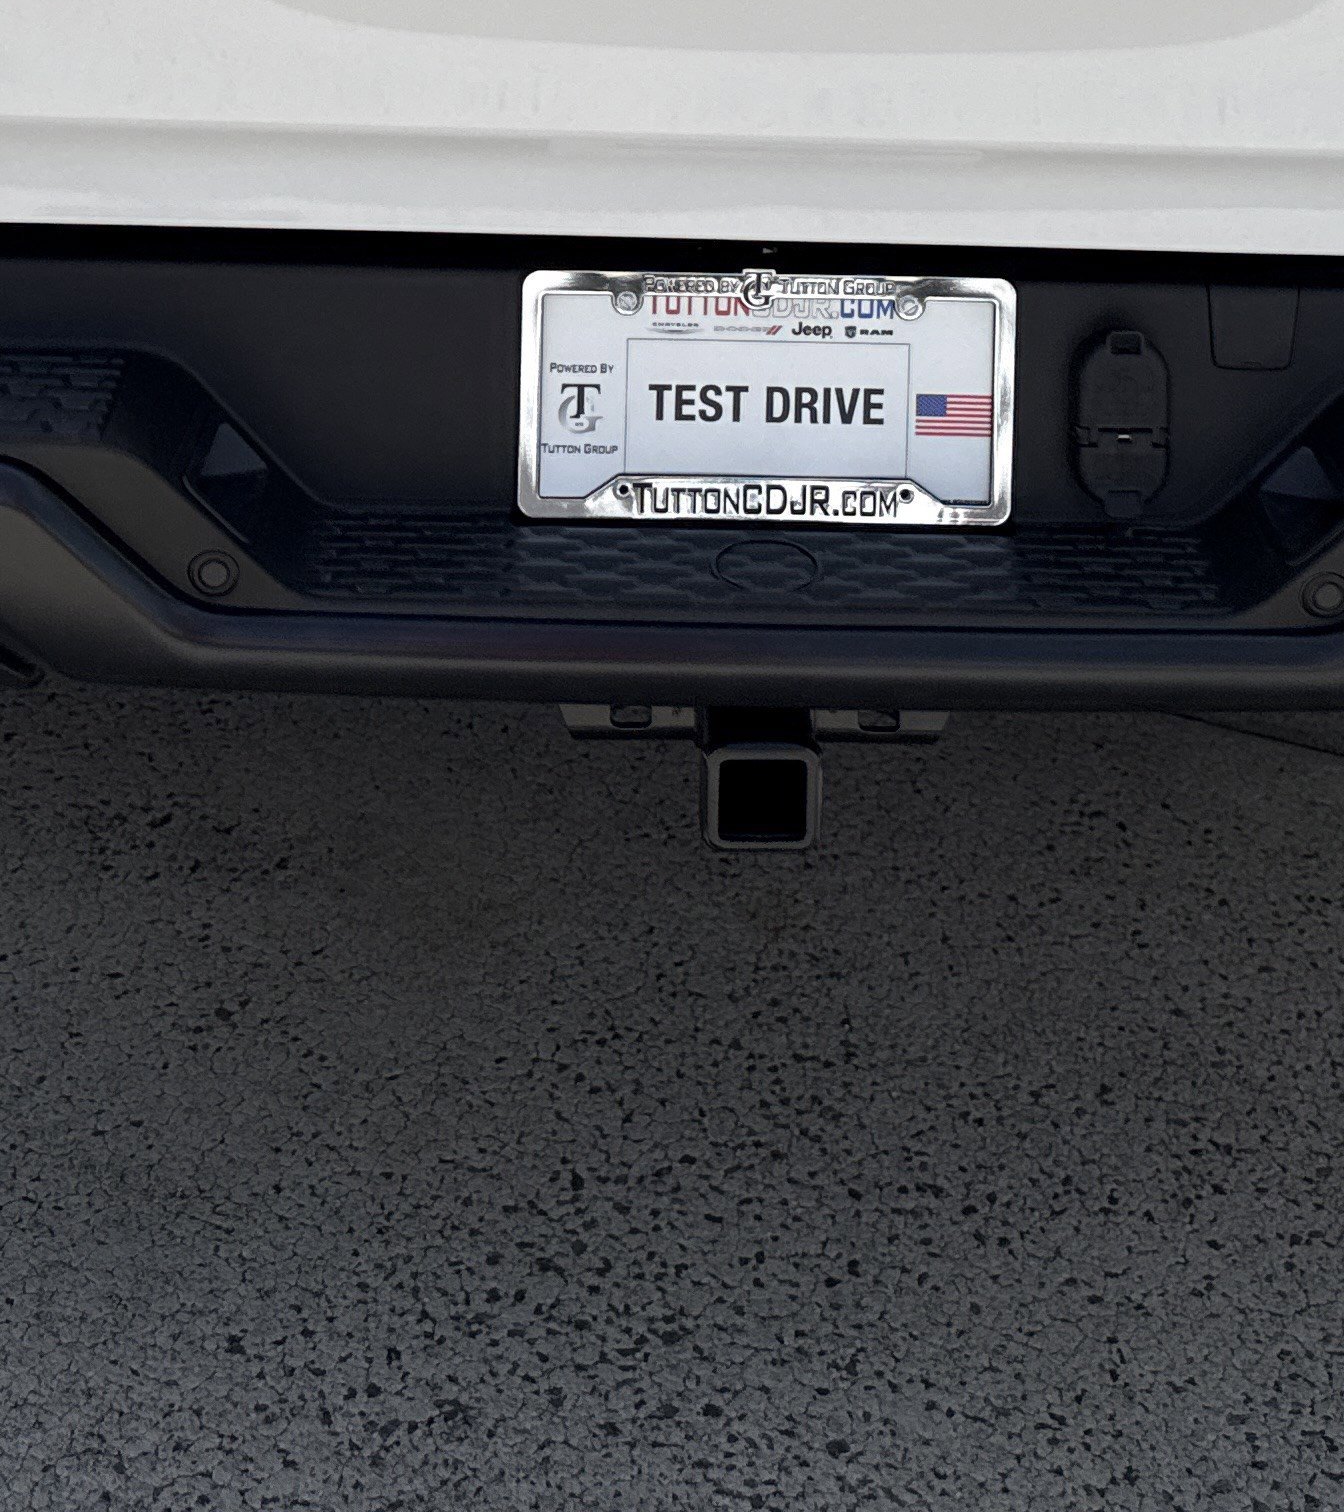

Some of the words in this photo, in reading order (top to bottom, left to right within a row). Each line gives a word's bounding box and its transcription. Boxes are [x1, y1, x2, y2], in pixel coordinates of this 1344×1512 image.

[791, 322, 833, 339] Jeep
[549, 362, 598, 374] POWERED
[647, 384, 750, 423] TEST
[764, 385, 886, 426] DRIVE
